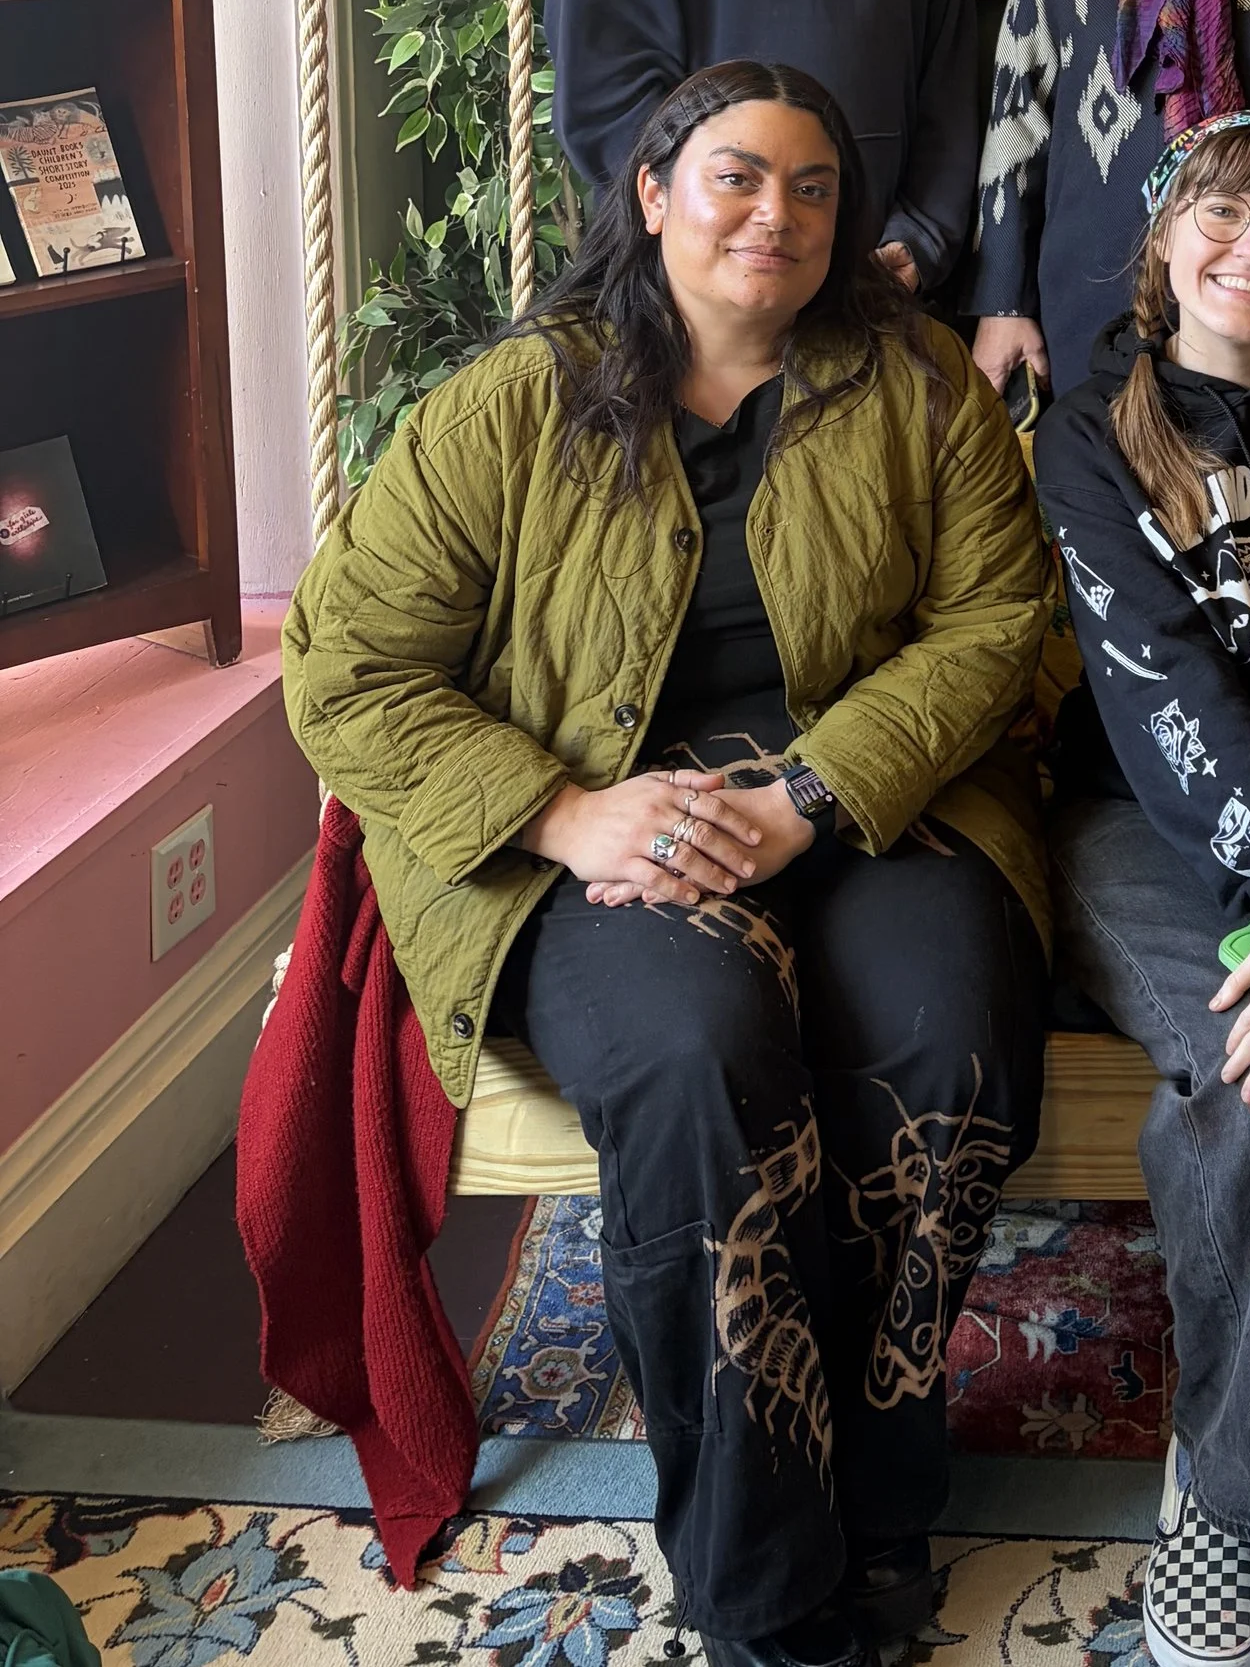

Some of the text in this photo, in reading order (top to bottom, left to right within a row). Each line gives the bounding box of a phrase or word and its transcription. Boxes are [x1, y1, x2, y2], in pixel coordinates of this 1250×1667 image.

[31, 142, 84, 159] DAUNT BOOKS
[39, 151, 83, 165] CHILDREN'S
[38, 160, 88, 176] SHORT STORY
[44, 170, 90, 183] COMPETITION
[58, 182, 76, 190] 2025
